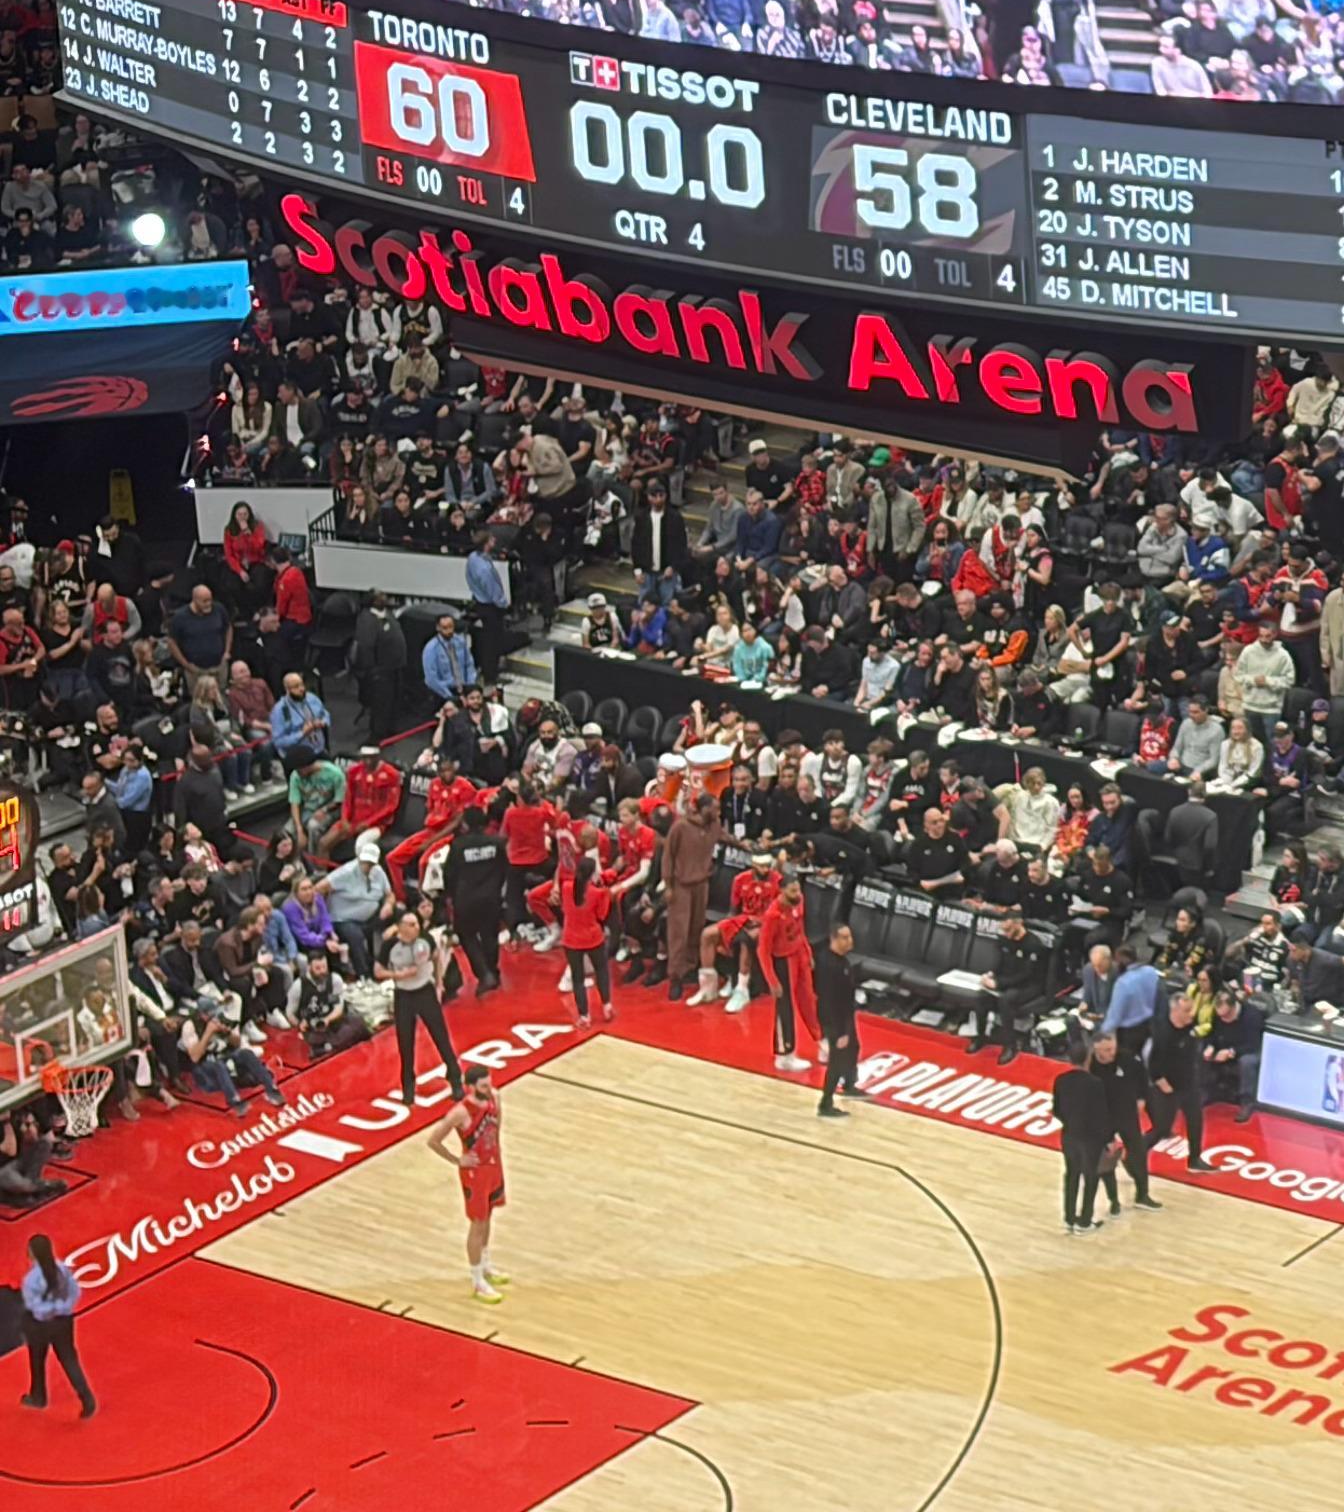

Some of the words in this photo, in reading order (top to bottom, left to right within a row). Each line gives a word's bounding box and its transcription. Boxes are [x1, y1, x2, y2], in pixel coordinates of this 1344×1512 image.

[218, 0, 237, 22] 13
[253, 8, 264, 30] 7
[367, 10, 489, 65] TORONTO
[61, 6, 76, 30] 12
[80, 12, 94, 36] C.
[97, 18, 217, 75] MURRAY-BOYLES
[222, 59, 241, 83] 12
[259, 69, 270, 91] 6
[223, 29, 233, 50] 7
[256, 39, 266, 60] 7
[64, 38, 79, 61] 14
[83, 46, 95, 67] J.
[97, 48, 157, 87] WALTER
[228, 91, 239, 113] 0
[262, 101, 272, 122] 7
[621, 60, 760, 112] TISSOT
[66, 68, 81, 90] 23
[86, 76, 98, 97] J.
[101, 81, 149, 113] SHEAD
[231, 122, 242, 144] 2
[265, 132, 276, 154] 2
[387, 61, 490, 157] 60
[826, 92, 1012, 144] CLEVELAND
[570, 100, 766, 209] 00.0
[1042, 144, 1054, 168] 1
[1073, 147, 1094, 172] J.
[1101, 150, 1208, 182] HARDEN
[377, 156, 403, 186] FLS
[416, 166, 442, 195] 00
[457, 175, 487, 205] TOL
[509, 187, 525, 214] 4
[853, 144, 979, 238] 58
[1043, 177, 1059, 201] 2
[1075, 180, 1102, 206] M.
[1110, 184, 1194, 214] STRUS
[615, 209, 668, 245] QTR
[688, 222, 706, 251] 4
[1038, 209, 1067, 233] 20
[1076, 213, 1097, 237] J.
[1103, 215, 1191, 246] TYSON
[832, 244, 865, 274] FLS
[880, 249, 912, 279] 00
[934, 258, 972, 287] TOL
[997, 264, 1016, 293] 4
[1040, 244, 1067, 268] 31
[1078, 248, 1099, 271] J.
[1106, 250, 1190, 280] ALLEN
[281, 195, 820, 381] Scotiabank
[847, 313, 1199, 433] Arena
[1043, 276, 1071, 299] 45
[1081, 279, 1106, 304] D.
[1112, 283, 1238, 317] MITCHELL
[64, 1155, 295, 1288] Michelob
